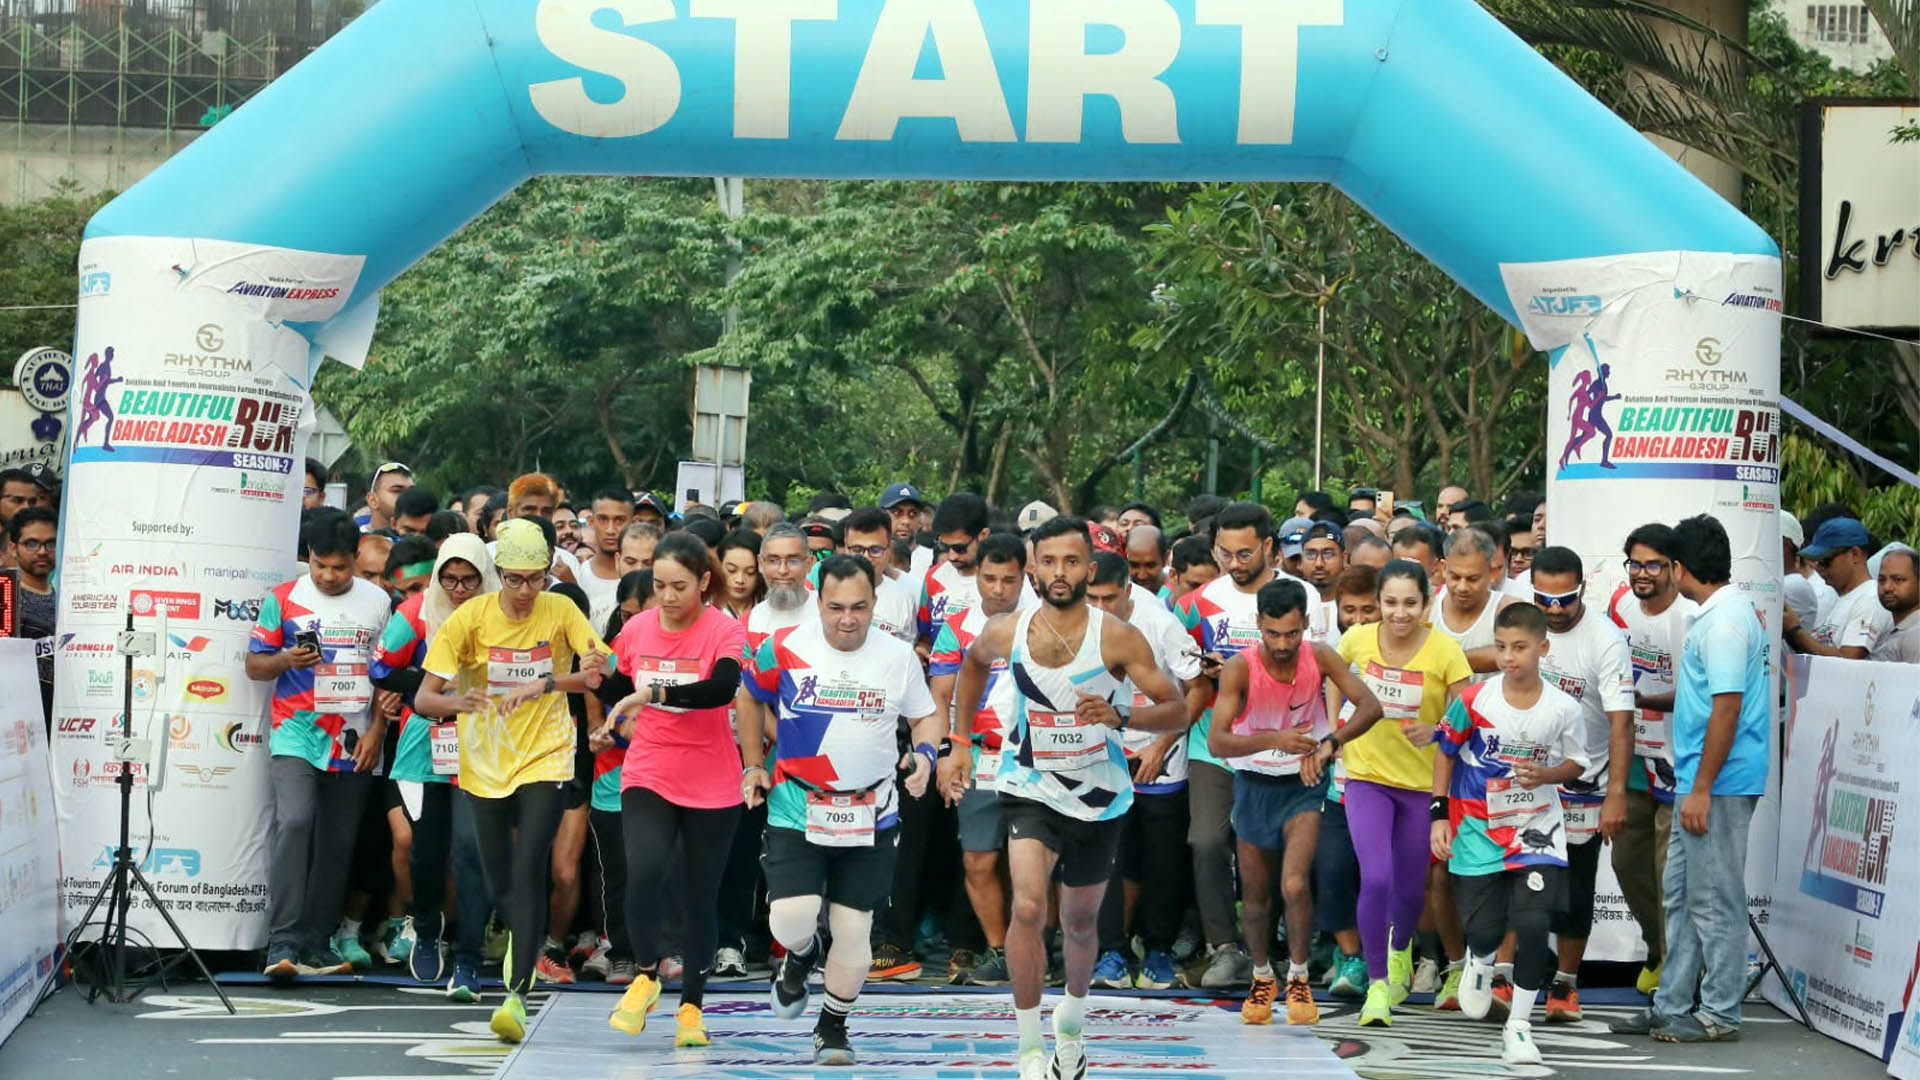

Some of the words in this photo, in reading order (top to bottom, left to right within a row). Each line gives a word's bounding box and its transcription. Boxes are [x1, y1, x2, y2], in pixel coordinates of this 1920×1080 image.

[528, 0, 1345, 145] START
[227, 280, 288, 298] AVIATION
[286, 288, 339, 300] EXPRESS
[1721, 293, 1766, 309] AVIATION
[164, 353, 252, 372] RHYTHM
[187, 368, 231, 378] GROUP
[1664, 369, 1748, 383] RHYTHM
[40, 381, 64, 392] THAI
[1689, 383, 1730, 391] GROUP
[117, 390, 236, 422] BEAUTIFUL
[111, 419, 229, 448] BANGLADESH
[226, 397, 293, 454] RUN
[1617, 406, 1735, 433] BEAUTIFUL
[1611, 436, 1729, 460] BANGLADESH
[1730, 408, 1779, 464] RUN
[233, 453, 289, 474] SEASON-2
[1735, 466, 1778, 483] SEASON-2
[132, 521, 178, 534] Supported
[111, 564, 135, 575] AIR
[138, 564, 179, 577] INDIA
[72, 593, 118, 602] AMERICAN
[506, 667, 535, 678] 7160
[330, 681, 356, 692] 7007
[818, 688, 858, 699] BEAUTIFUL
[1376, 684, 1402, 698] 7121
[816, 697, 856, 707] BANGLADESH
[57, 717, 97, 733] UCR
[1050, 733, 1083, 744] 7032
[1505, 792, 1534, 804] 7220
[825, 812, 855, 823] 7093
[157, 881, 189, 894] Forum
[190, 881, 202, 895] of
